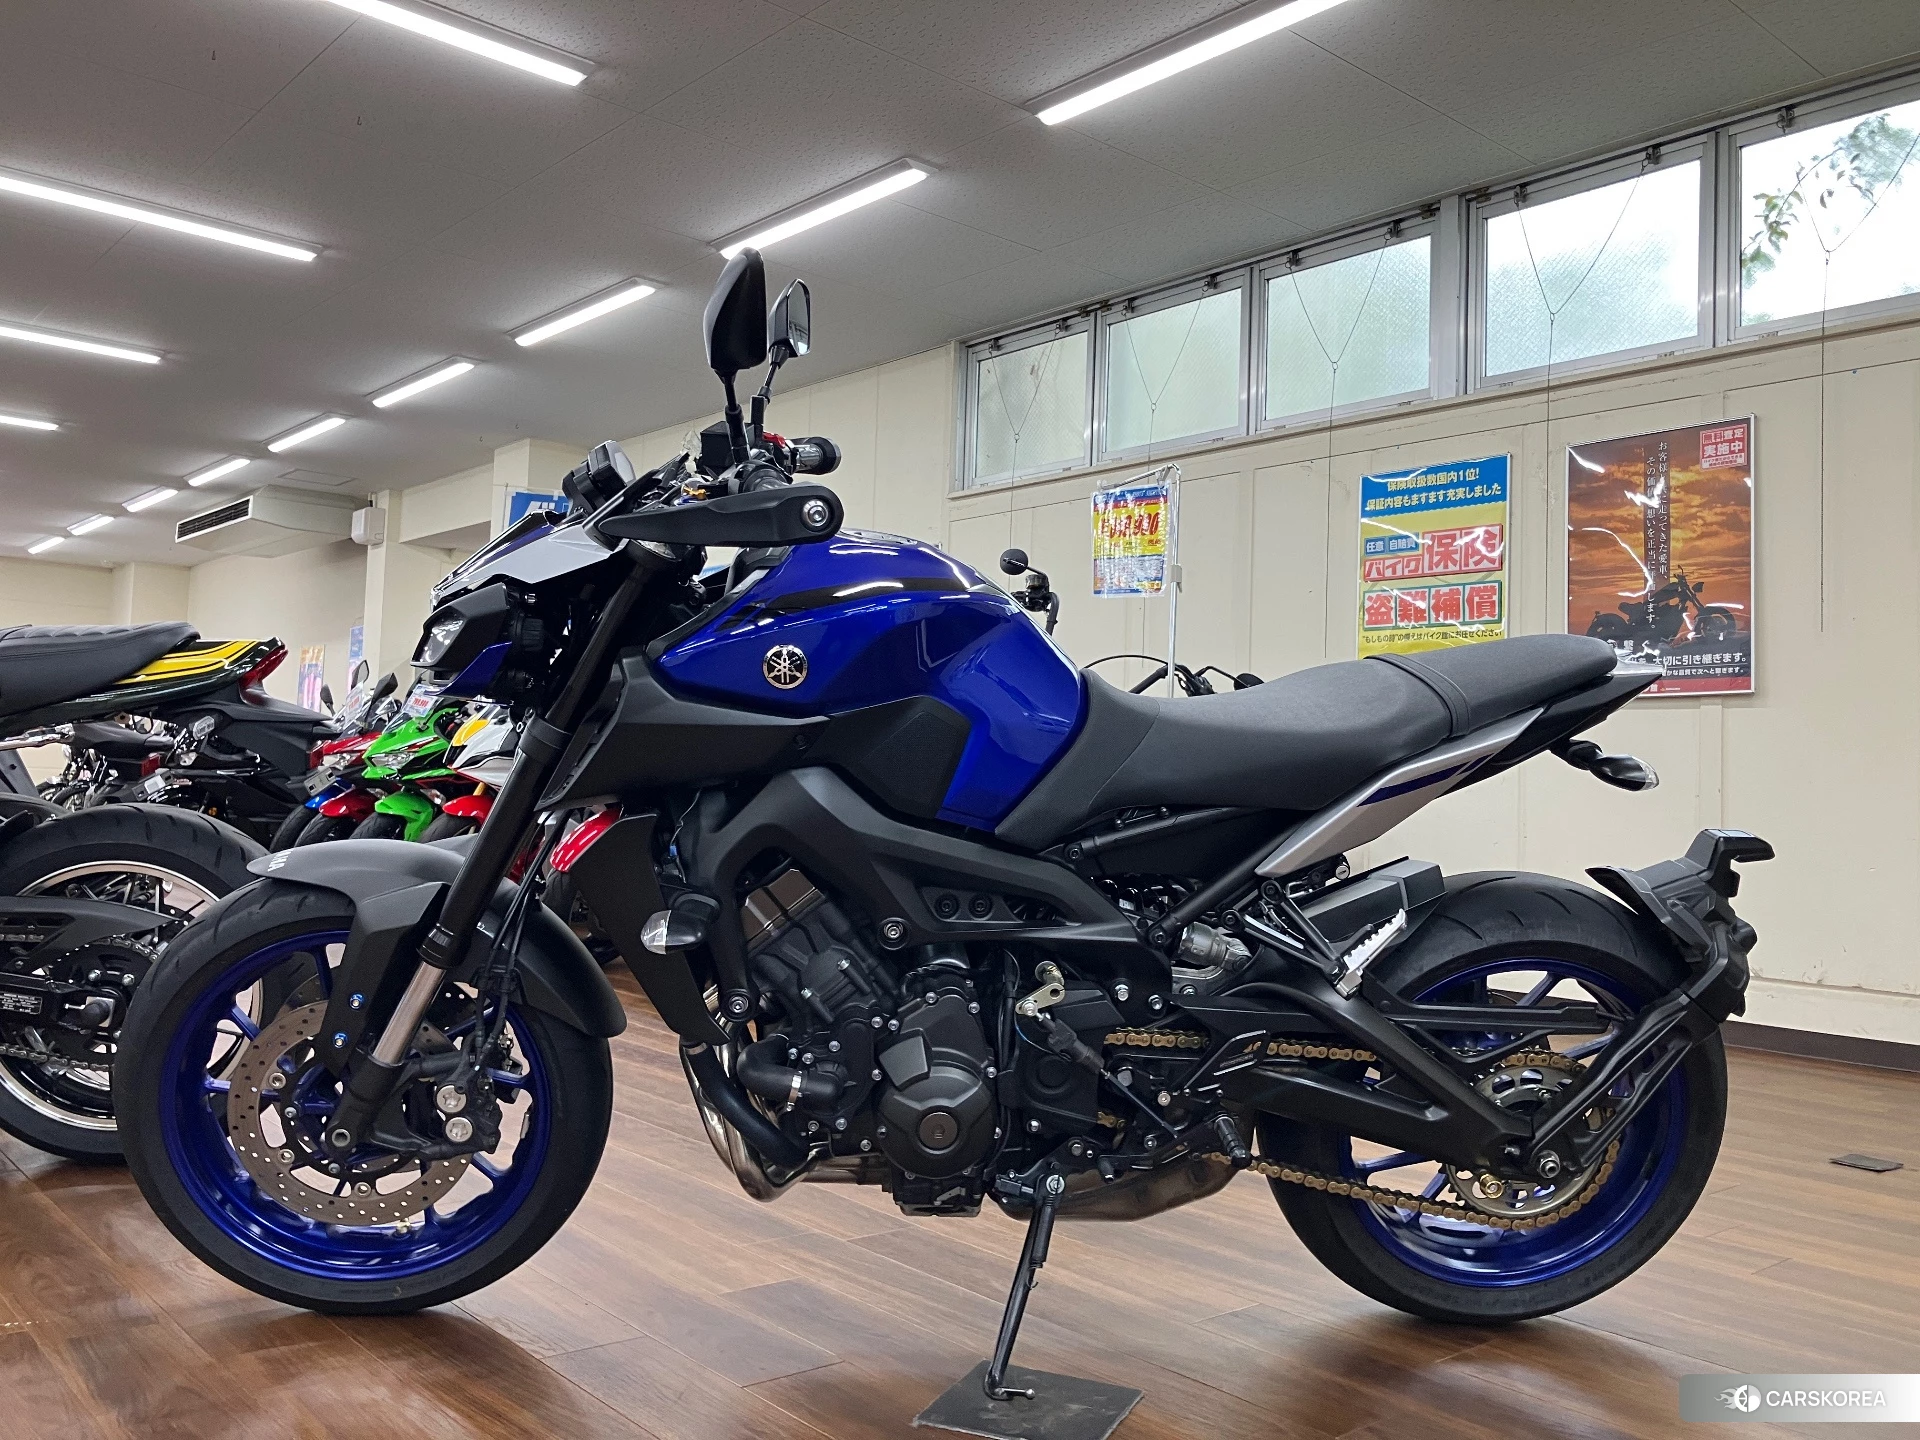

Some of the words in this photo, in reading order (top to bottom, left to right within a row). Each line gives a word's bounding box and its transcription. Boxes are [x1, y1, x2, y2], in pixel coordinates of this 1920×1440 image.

[1703, 440, 1743, 458] 実施中
[1366, 482, 1502, 511] 保証内容もますます充実しました
[1365, 584, 1498, 625] 盗難補償
